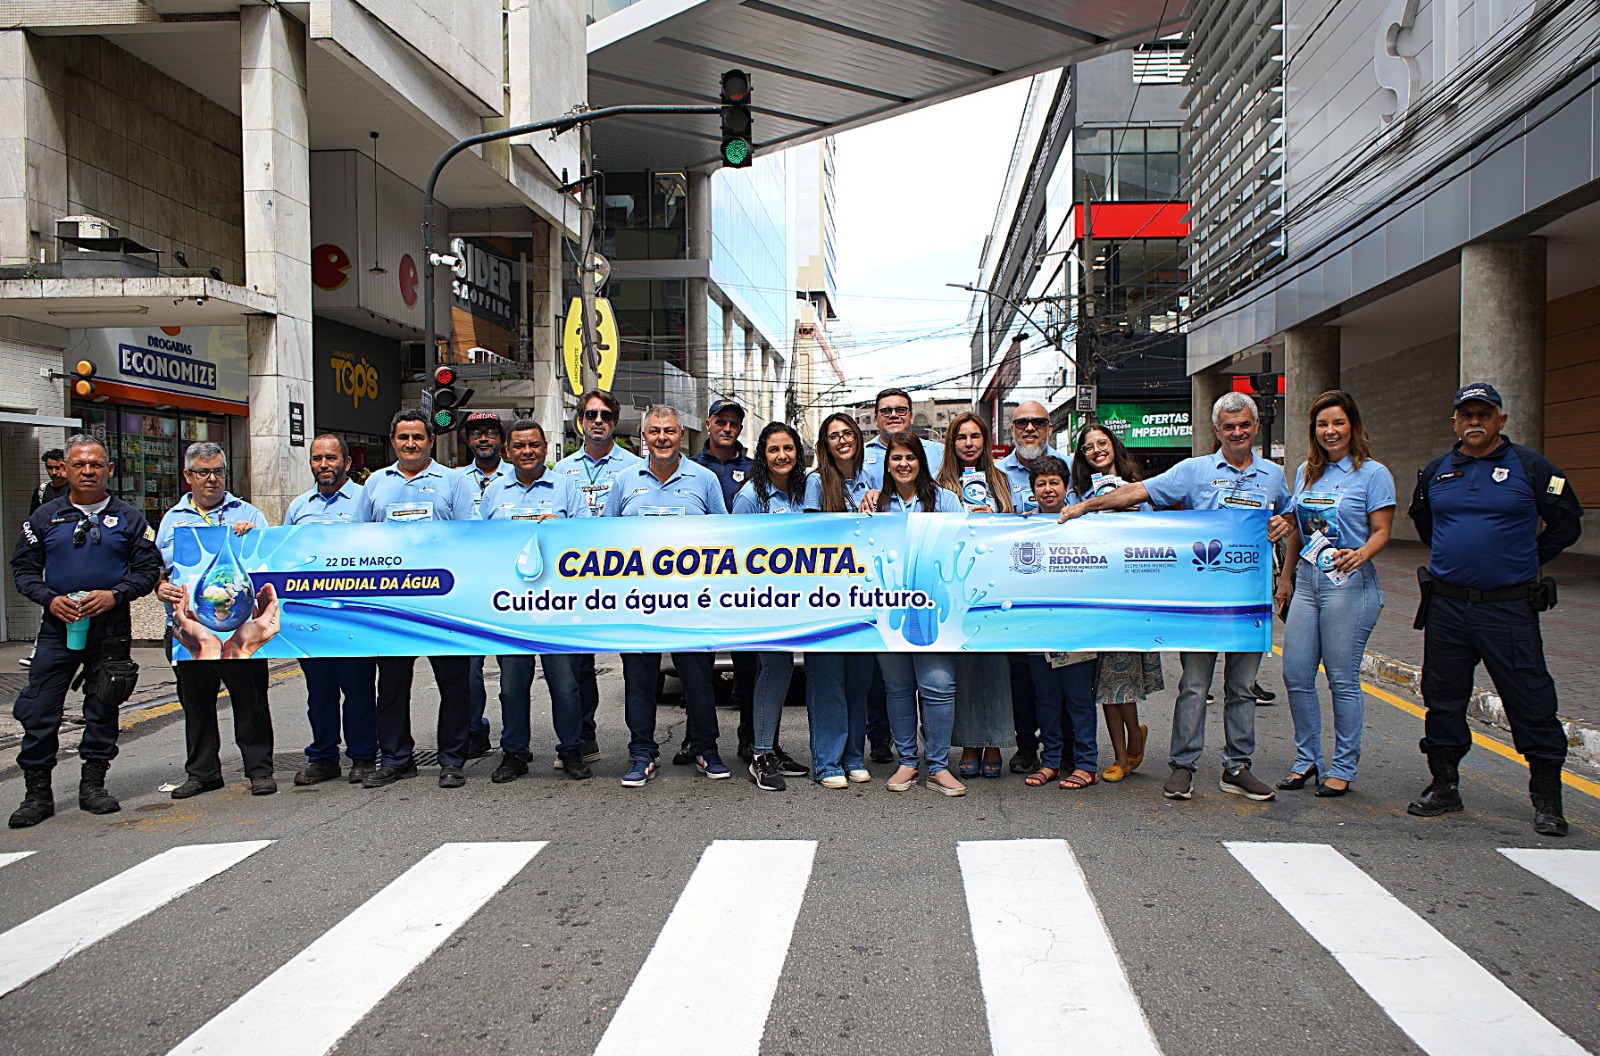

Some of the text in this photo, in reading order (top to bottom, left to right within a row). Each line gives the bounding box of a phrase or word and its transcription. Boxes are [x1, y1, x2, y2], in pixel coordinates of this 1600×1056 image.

[450, 238, 511, 302] SIDER
[452, 280, 510, 319] SHOPPING
[148, 335, 193, 355] DROGARIAS
[122, 348, 215, 386] ECONOMIZE
[1141, 412, 1190, 425] OFERTAS
[1131, 423, 1193, 438] IMPERDÍVEIS
[1048, 546, 1090, 555] VOLTA
[1123, 547, 1178, 559] SMMA
[1224, 551, 1260, 564] saae
[325, 556, 402, 568] 22 DE MARÇO
[557, 546, 867, 579] CADA GOTA CONTA.
[1049, 555, 1108, 565] REDONDA
[285, 573, 441, 592] DIA MUNDIAL DA ÁGUA
[492, 585, 934, 615] Cuidar da água é cuidar do futuro.
